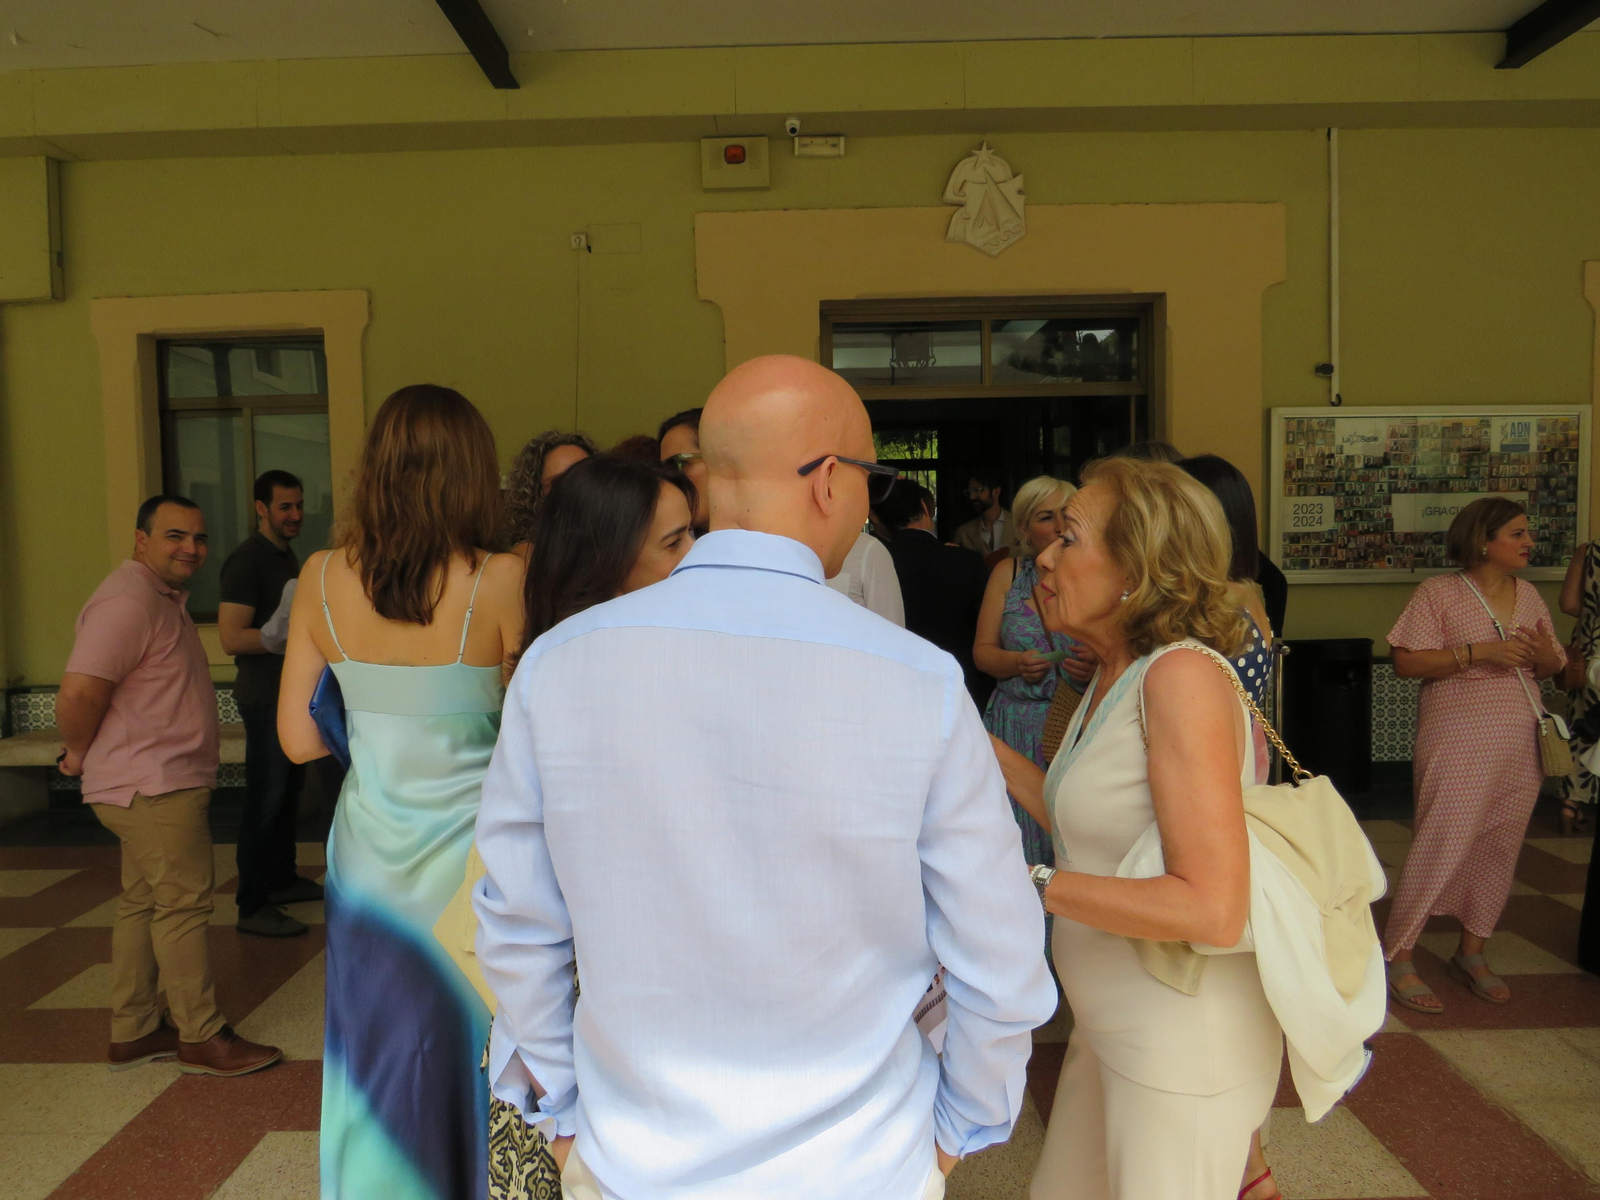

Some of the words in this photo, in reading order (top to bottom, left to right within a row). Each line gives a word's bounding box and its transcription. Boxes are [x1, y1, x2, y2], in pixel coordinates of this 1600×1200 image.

[1510, 422, 1531, 438] ADN
[1293, 503, 1324, 515] 2023
[1293, 515, 1324, 527] 2024
